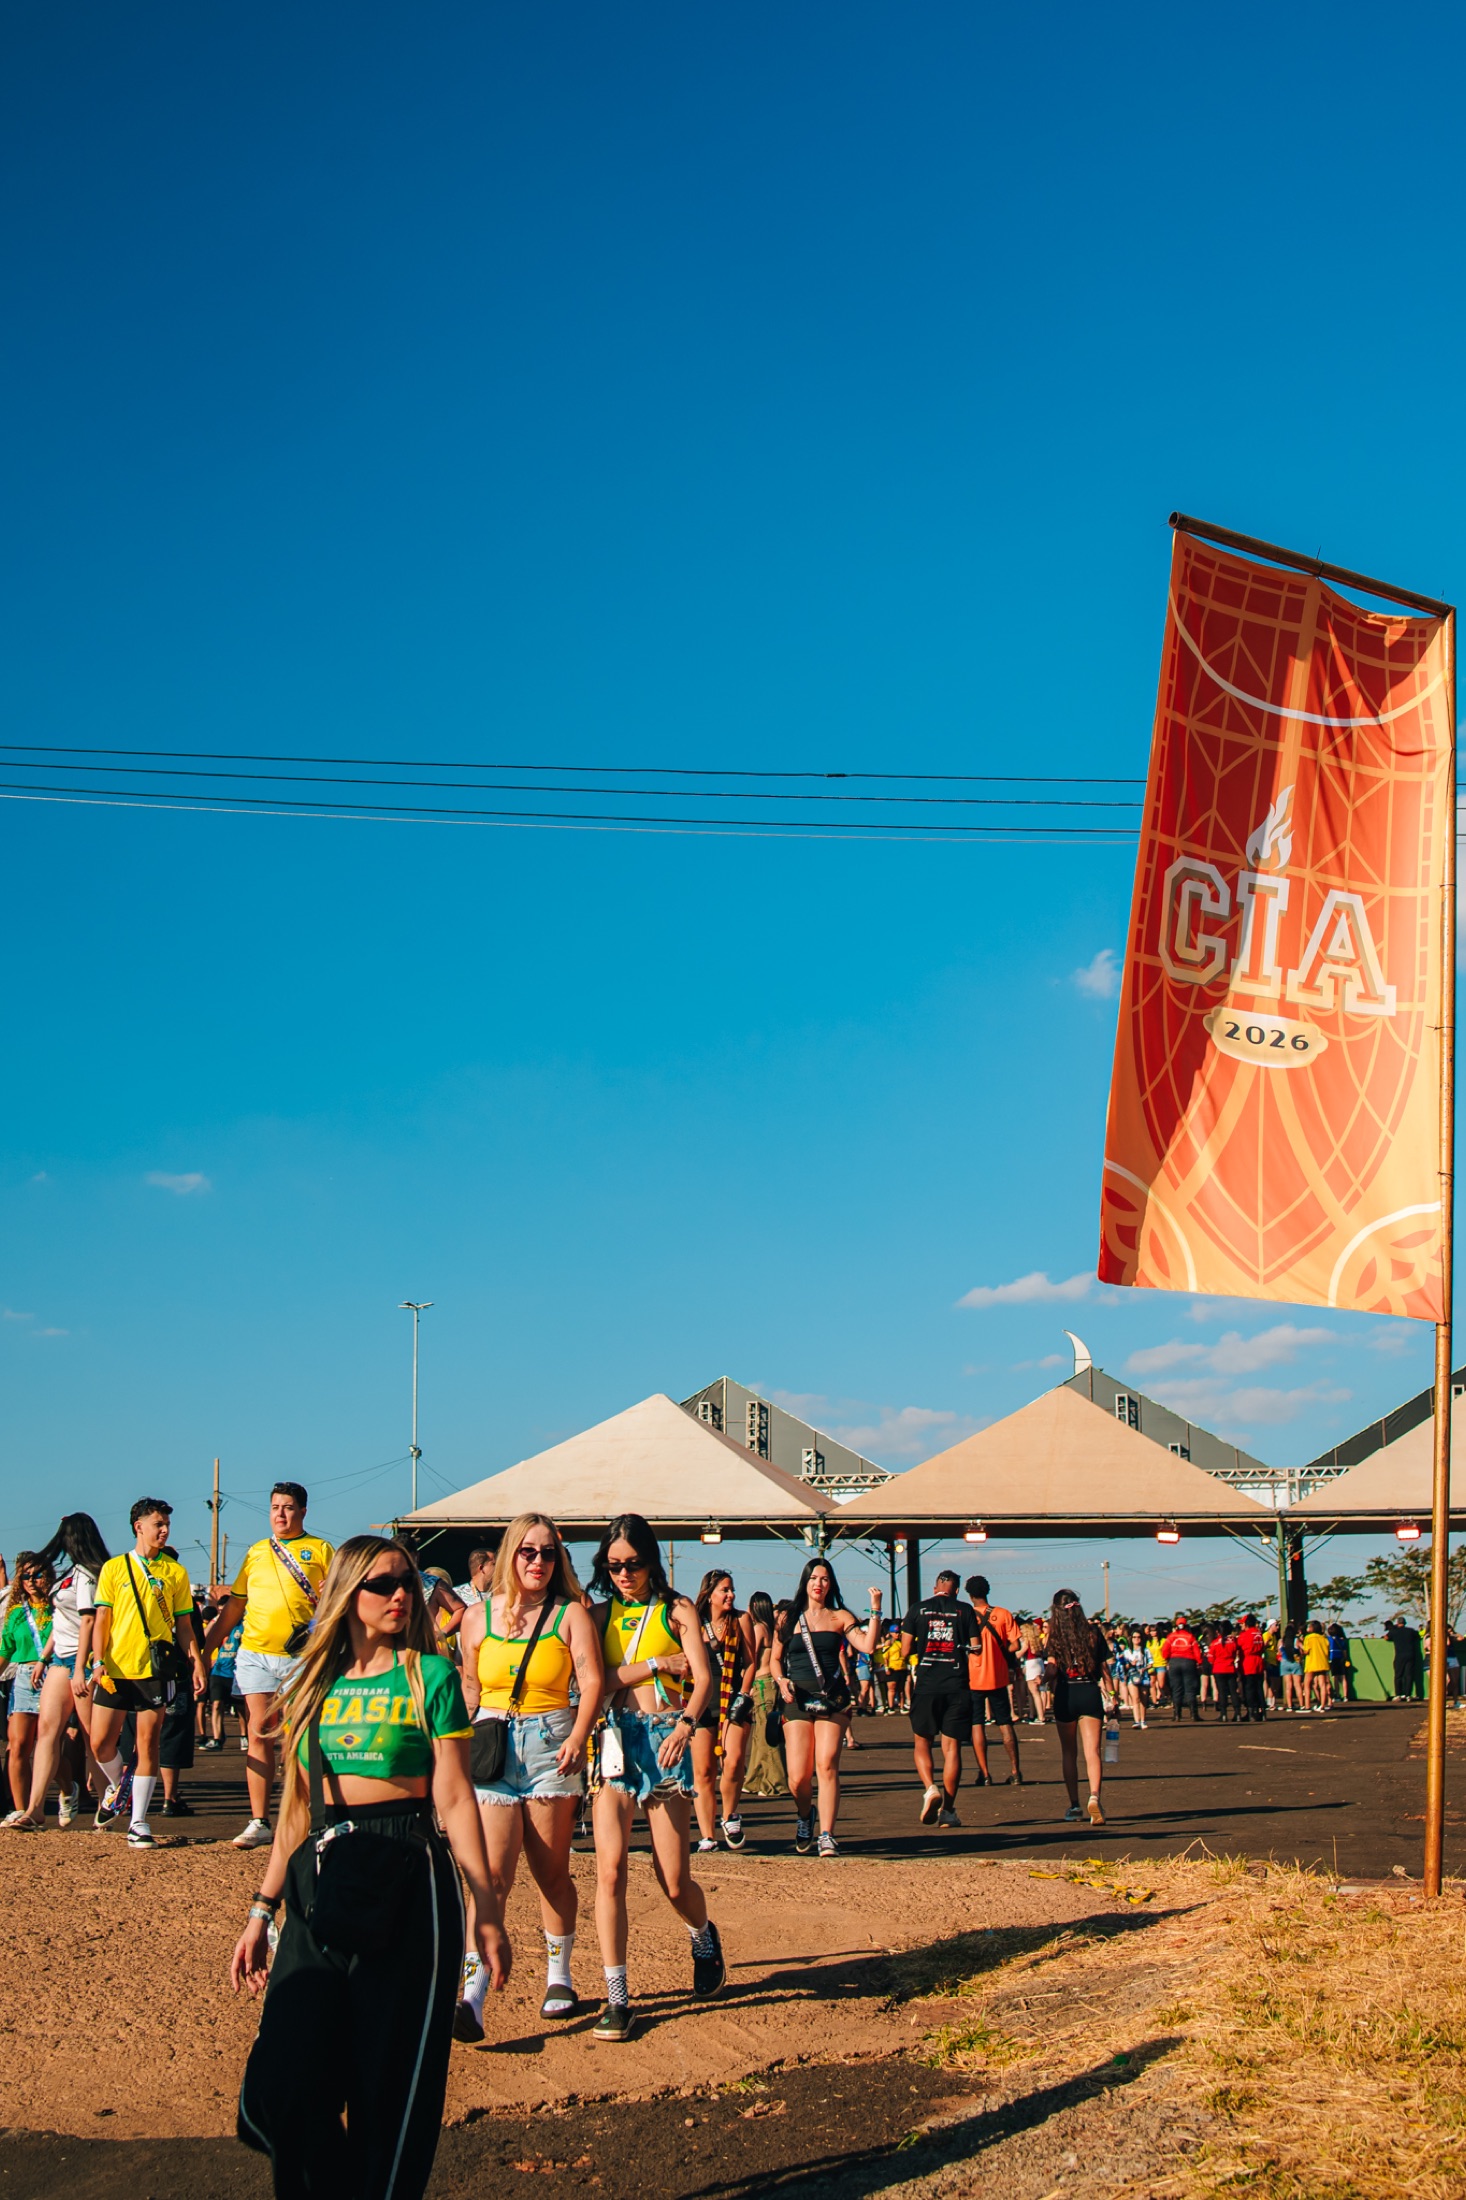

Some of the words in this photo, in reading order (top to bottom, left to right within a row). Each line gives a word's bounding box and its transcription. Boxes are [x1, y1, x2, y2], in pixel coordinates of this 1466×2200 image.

[1158, 855, 1397, 1016] CIA
[1224, 1021, 1310, 1051] 2026
[333, 1687, 390, 1696] PINDORAMA
[319, 1695, 418, 1725] RASIL
[346, 1752, 384, 1761] AMERICA
